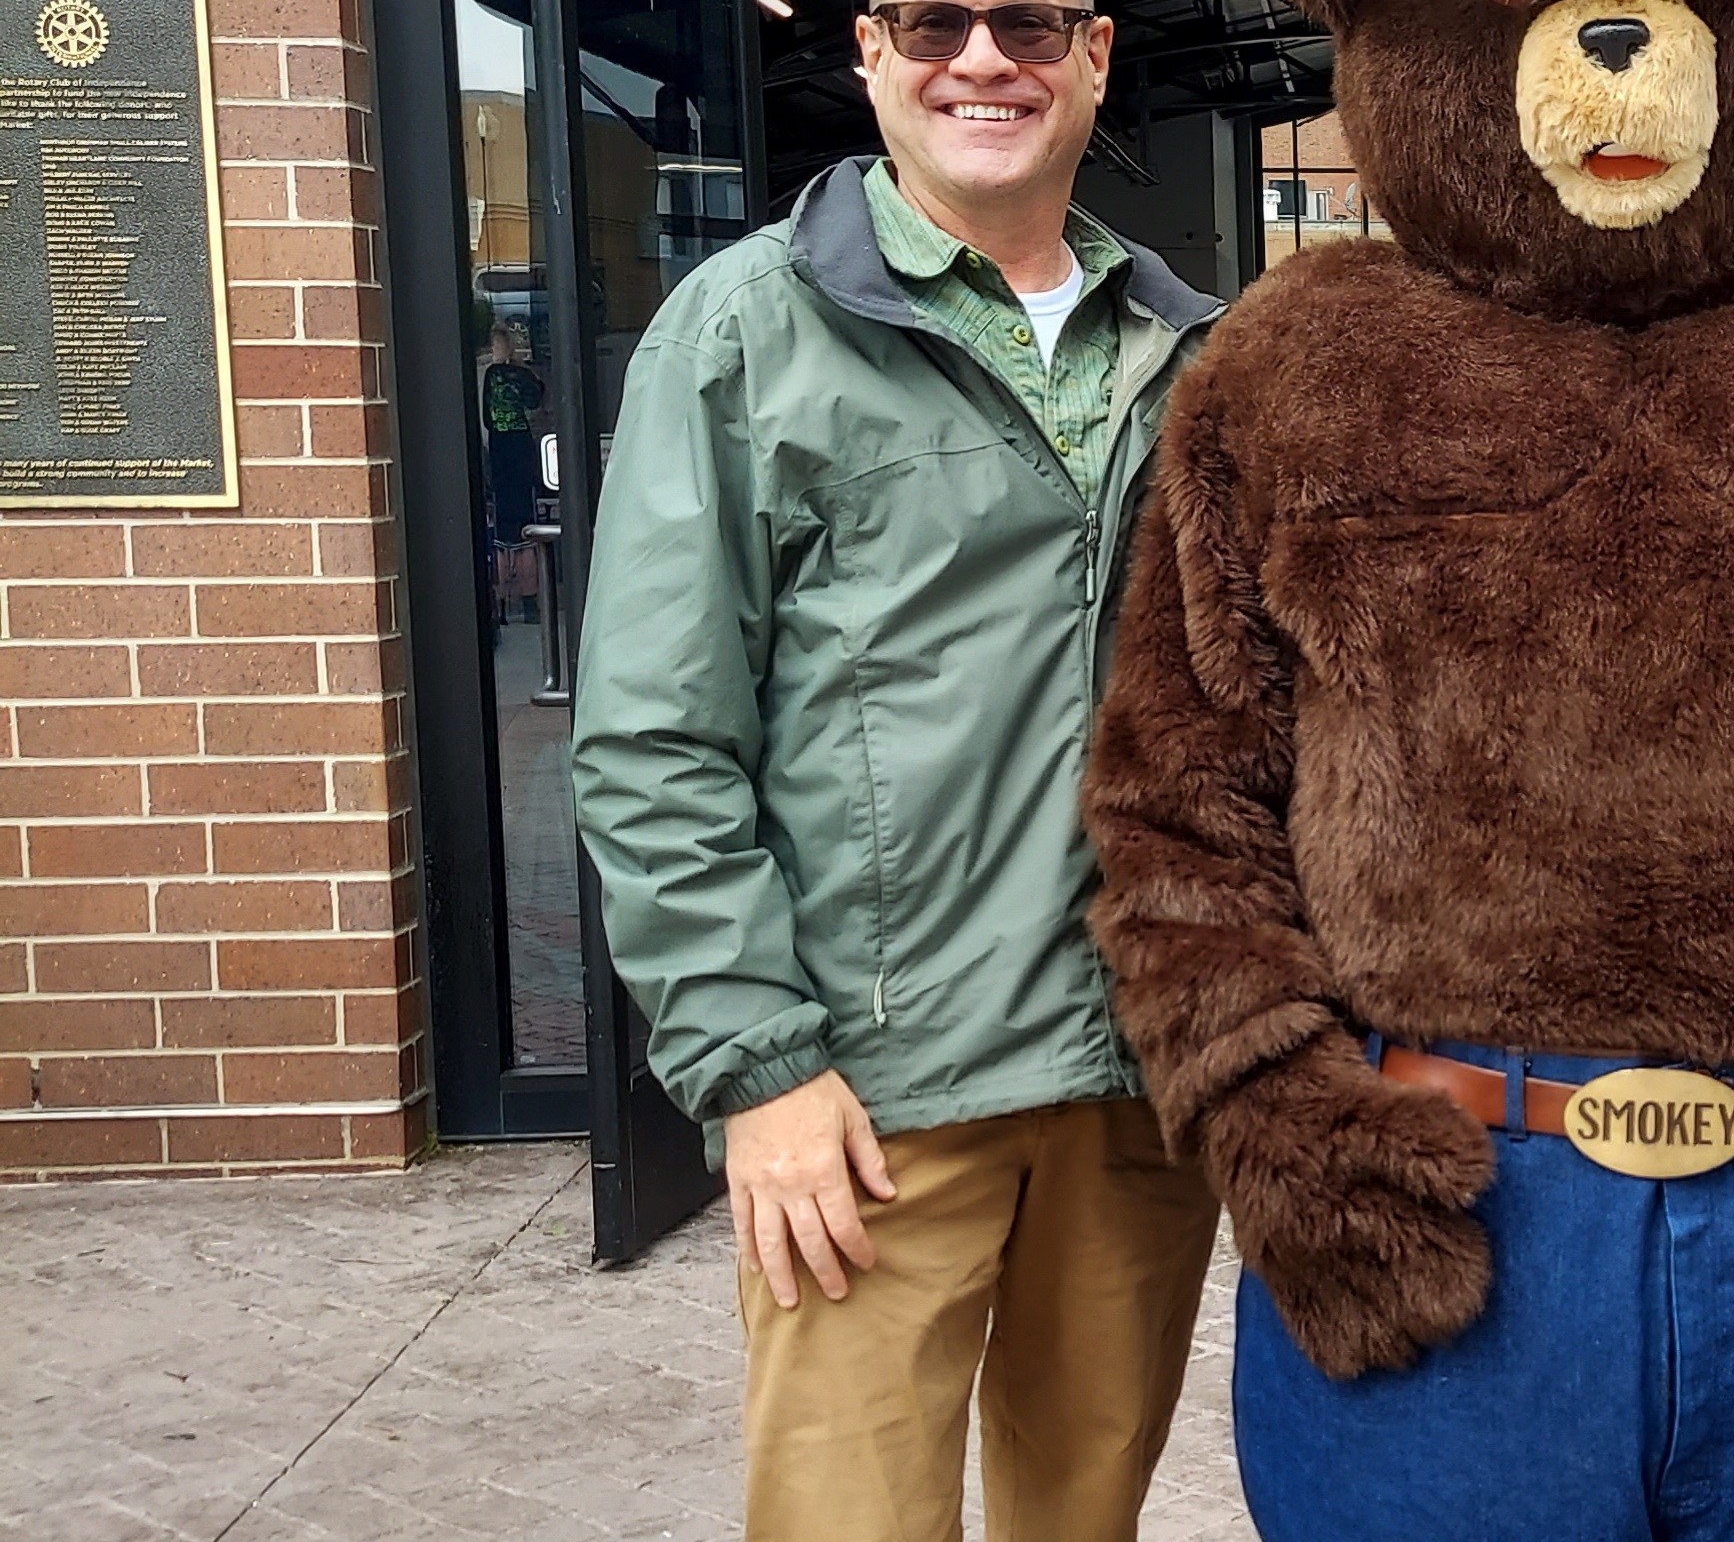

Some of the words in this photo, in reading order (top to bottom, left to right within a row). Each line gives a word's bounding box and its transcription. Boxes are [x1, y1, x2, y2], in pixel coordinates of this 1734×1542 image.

[18, 78, 49, 88] Rotary
[50, 78, 71, 87] Club
[72, 78, 83, 87] of
[3, 460, 30, 469] many
[56, 458, 68, 467] of
[66, 469, 117, 479] community
